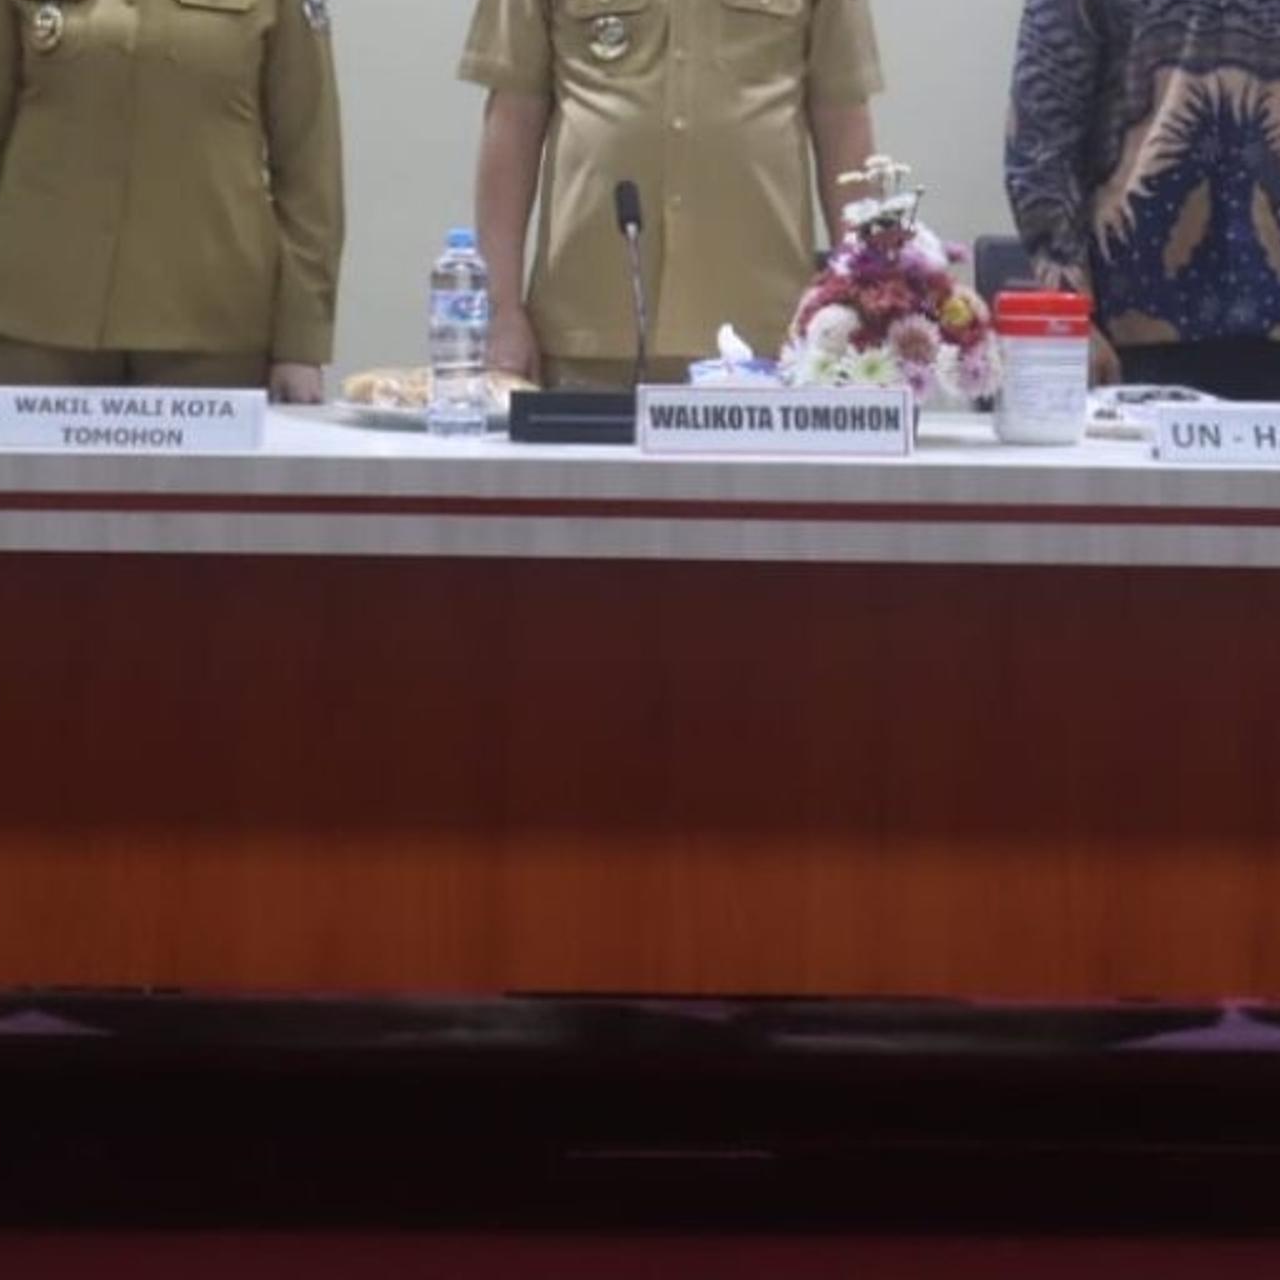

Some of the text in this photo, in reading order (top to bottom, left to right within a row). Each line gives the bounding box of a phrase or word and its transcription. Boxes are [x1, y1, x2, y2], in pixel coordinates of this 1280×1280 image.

[14, 396, 235, 418] WAKIL WALI KOTA
[649, 405, 900, 432] WALIKOTA TOMOHON
[61, 427, 183, 447] TOMOHON
[1171, 423, 1221, 448] UN
